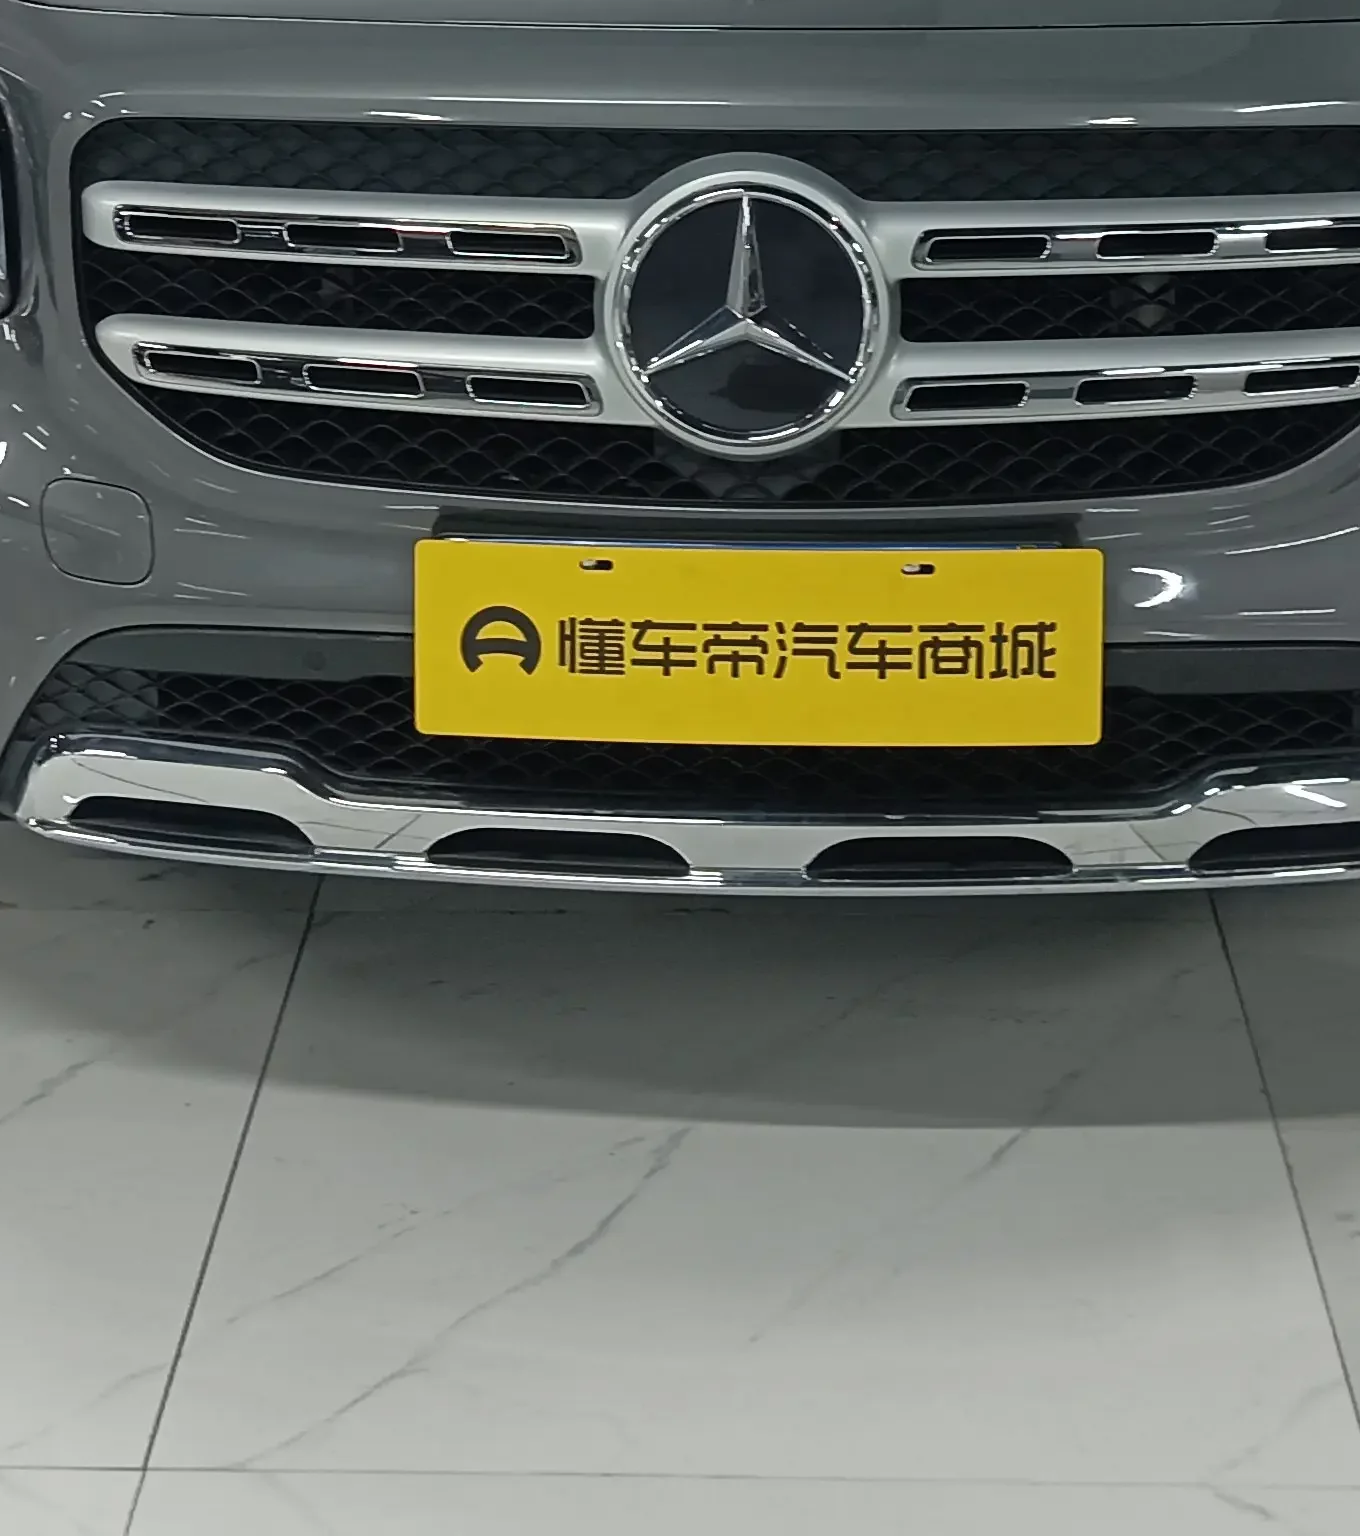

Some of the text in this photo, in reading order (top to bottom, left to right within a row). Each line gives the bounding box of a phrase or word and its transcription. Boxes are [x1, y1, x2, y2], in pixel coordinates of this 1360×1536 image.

[557, 616, 1058, 681] 懂车帝汽车商城
